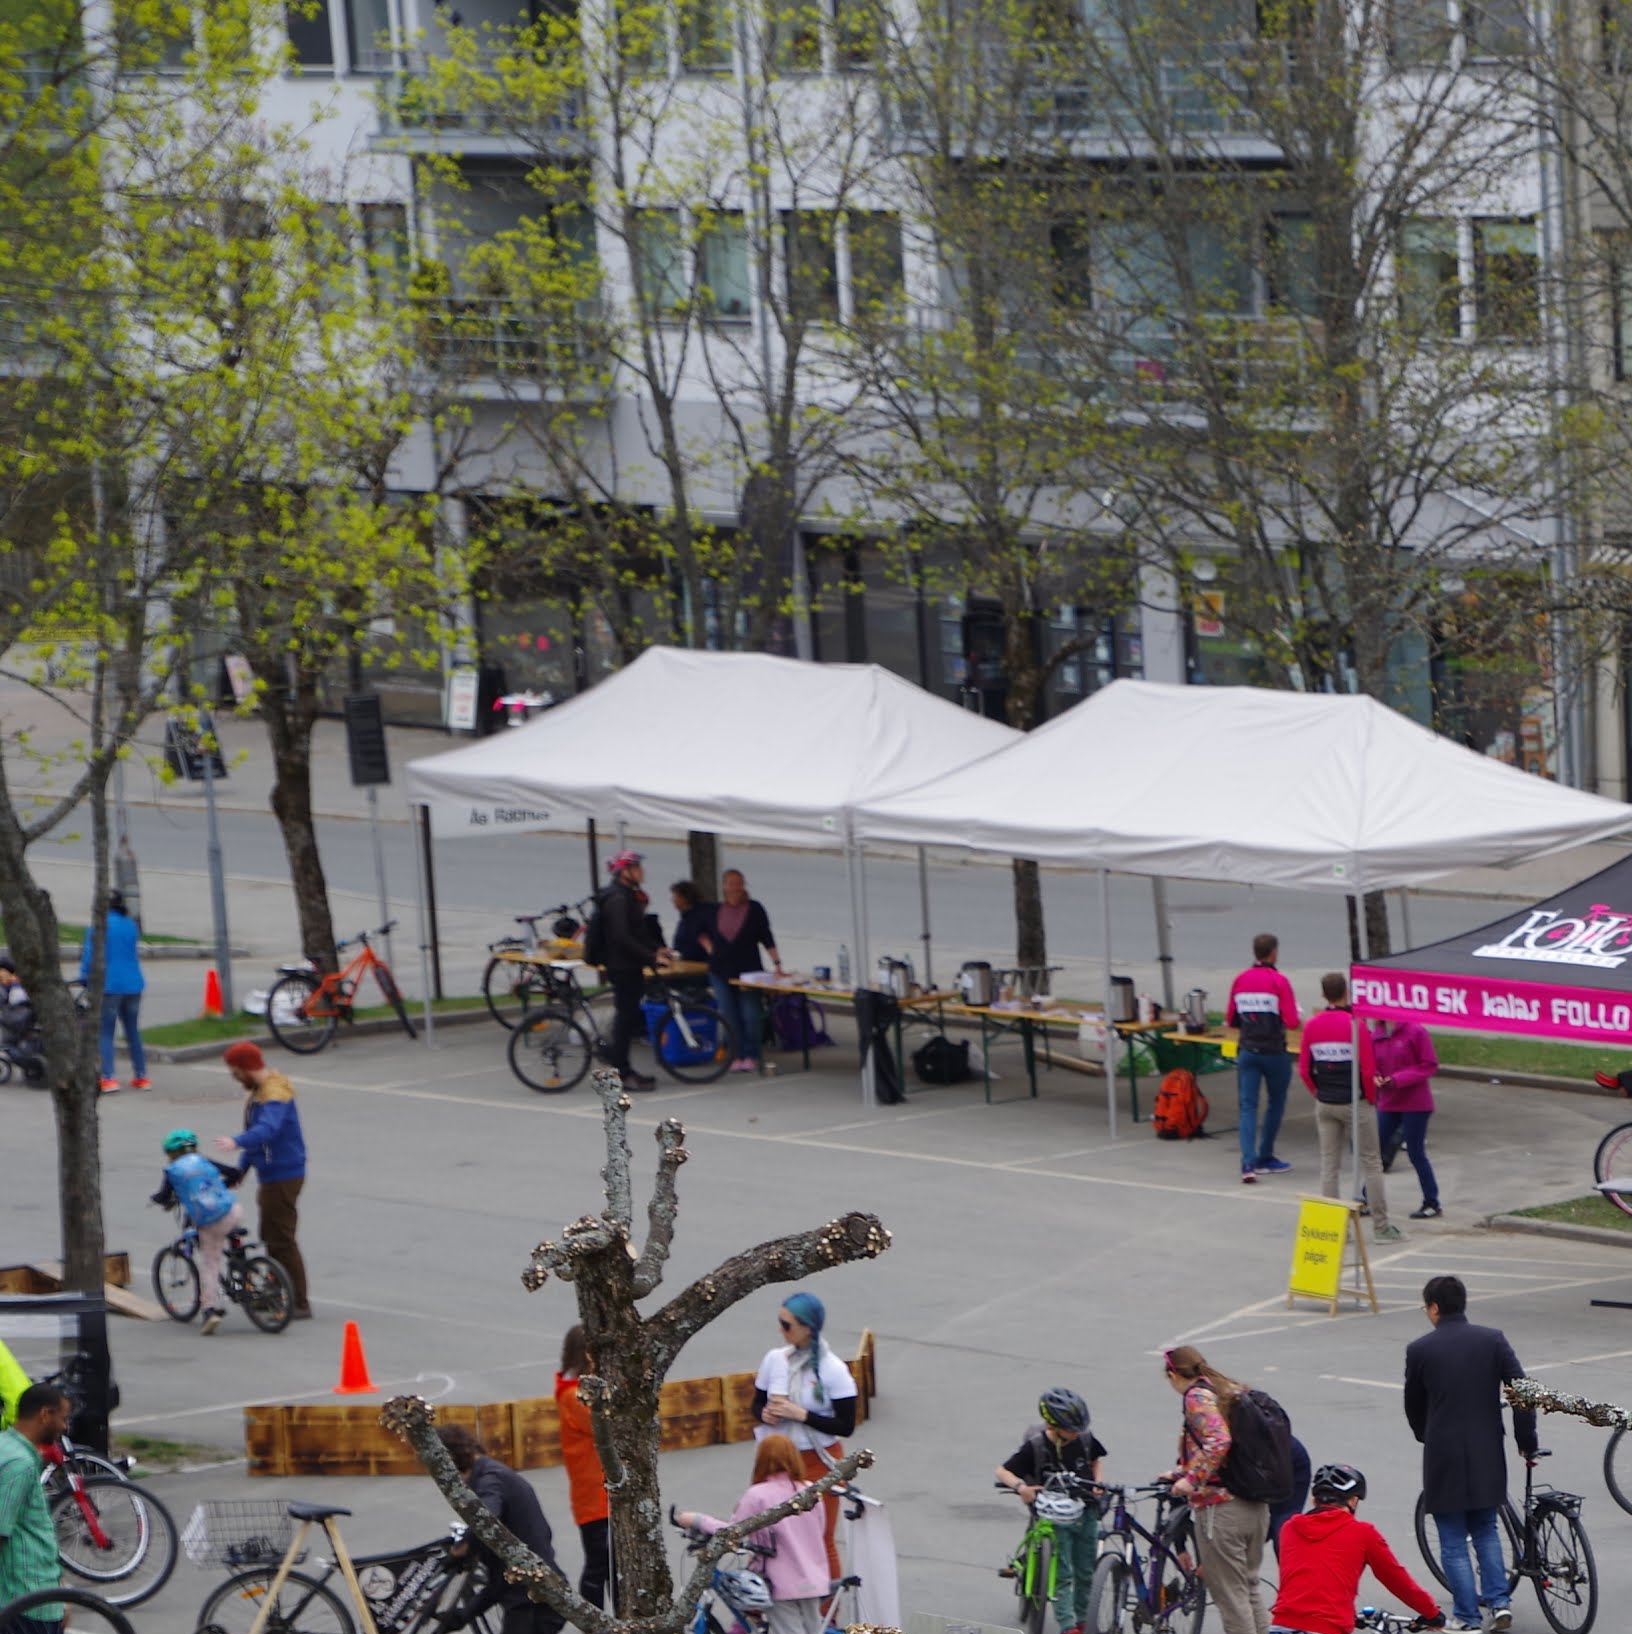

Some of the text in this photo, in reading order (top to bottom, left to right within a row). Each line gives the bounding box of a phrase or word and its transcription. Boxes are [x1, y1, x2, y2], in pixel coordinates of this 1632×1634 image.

[1351, 978, 1431, 1011] FOLLO
[1435, 986, 1470, 1015] SK
[1481, 990, 1542, 1022] kalas
[1550, 997, 1631, 1032] FOLLO
